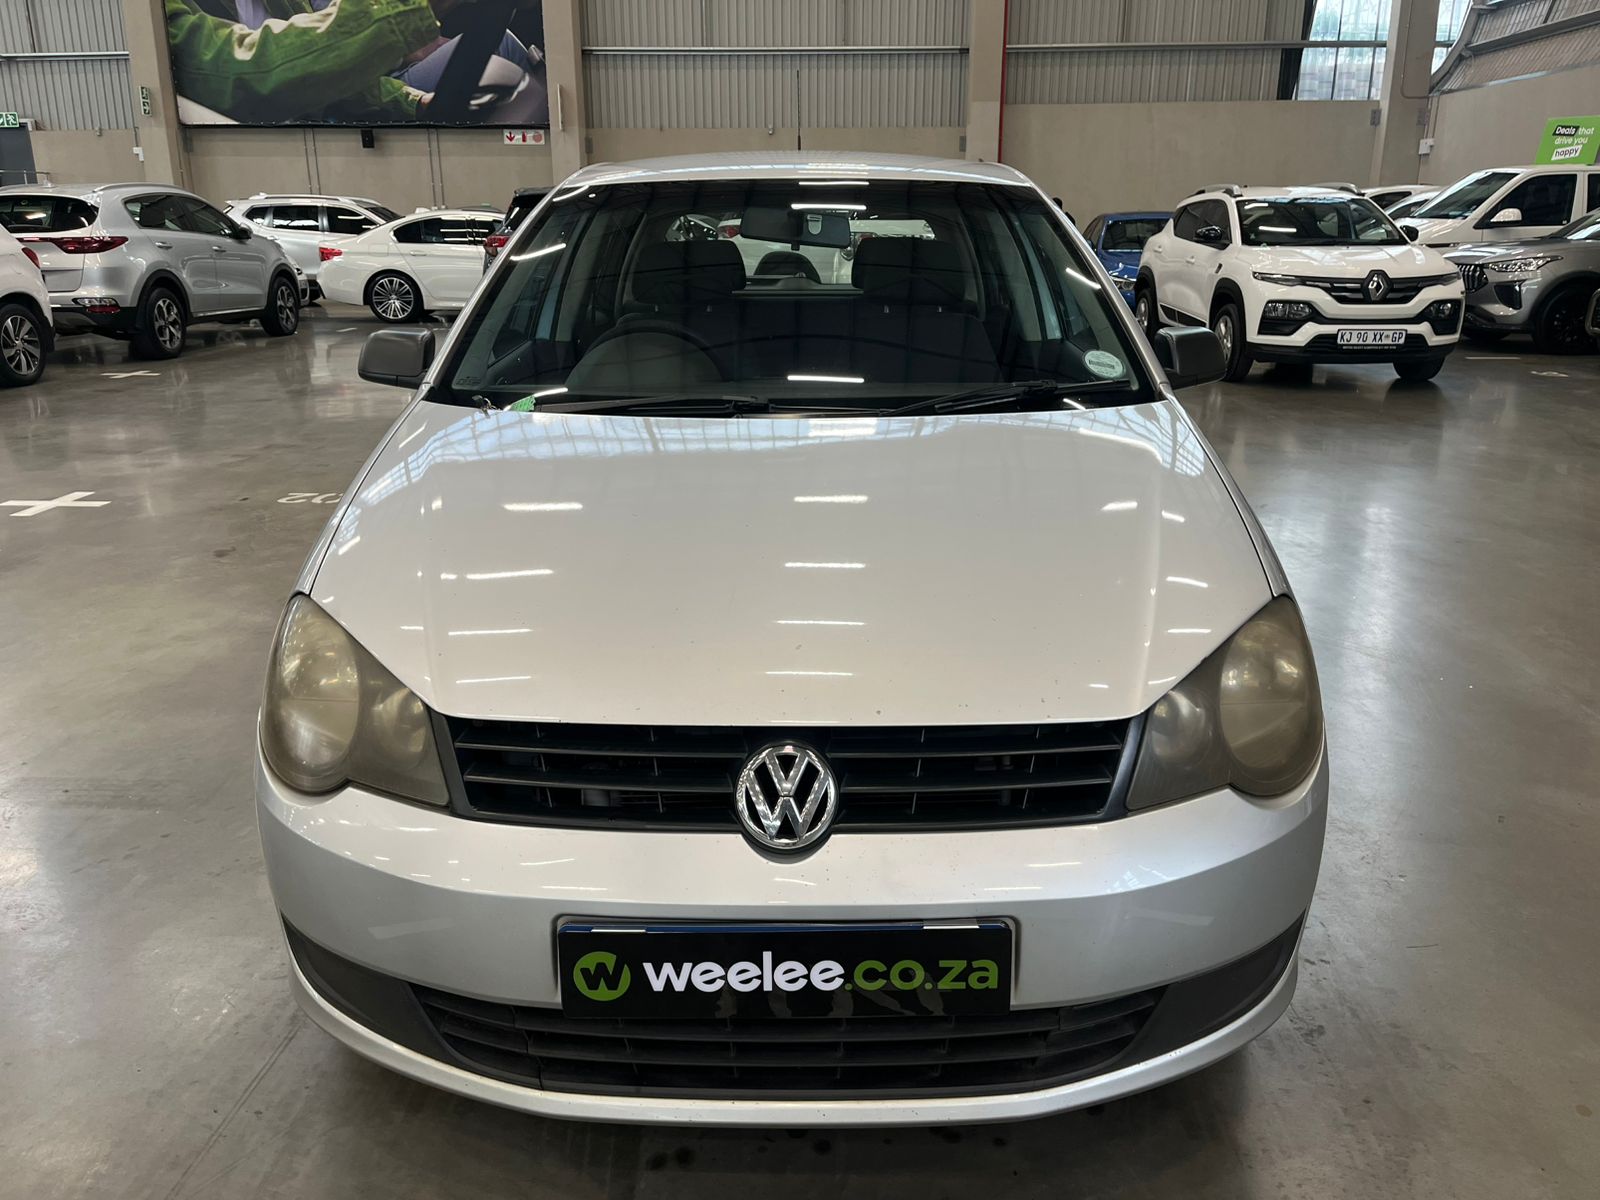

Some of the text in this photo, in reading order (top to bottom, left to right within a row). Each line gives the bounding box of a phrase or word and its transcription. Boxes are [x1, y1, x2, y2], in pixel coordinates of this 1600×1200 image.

[1556, 126, 1576, 134] Deals
[1554, 136, 1588, 146] drive you
[1555, 148, 1580, 157] happy
[1339, 331, 1404, 343] KJ 90 XX GP
[642, 950, 999, 993] weelee.co.za
